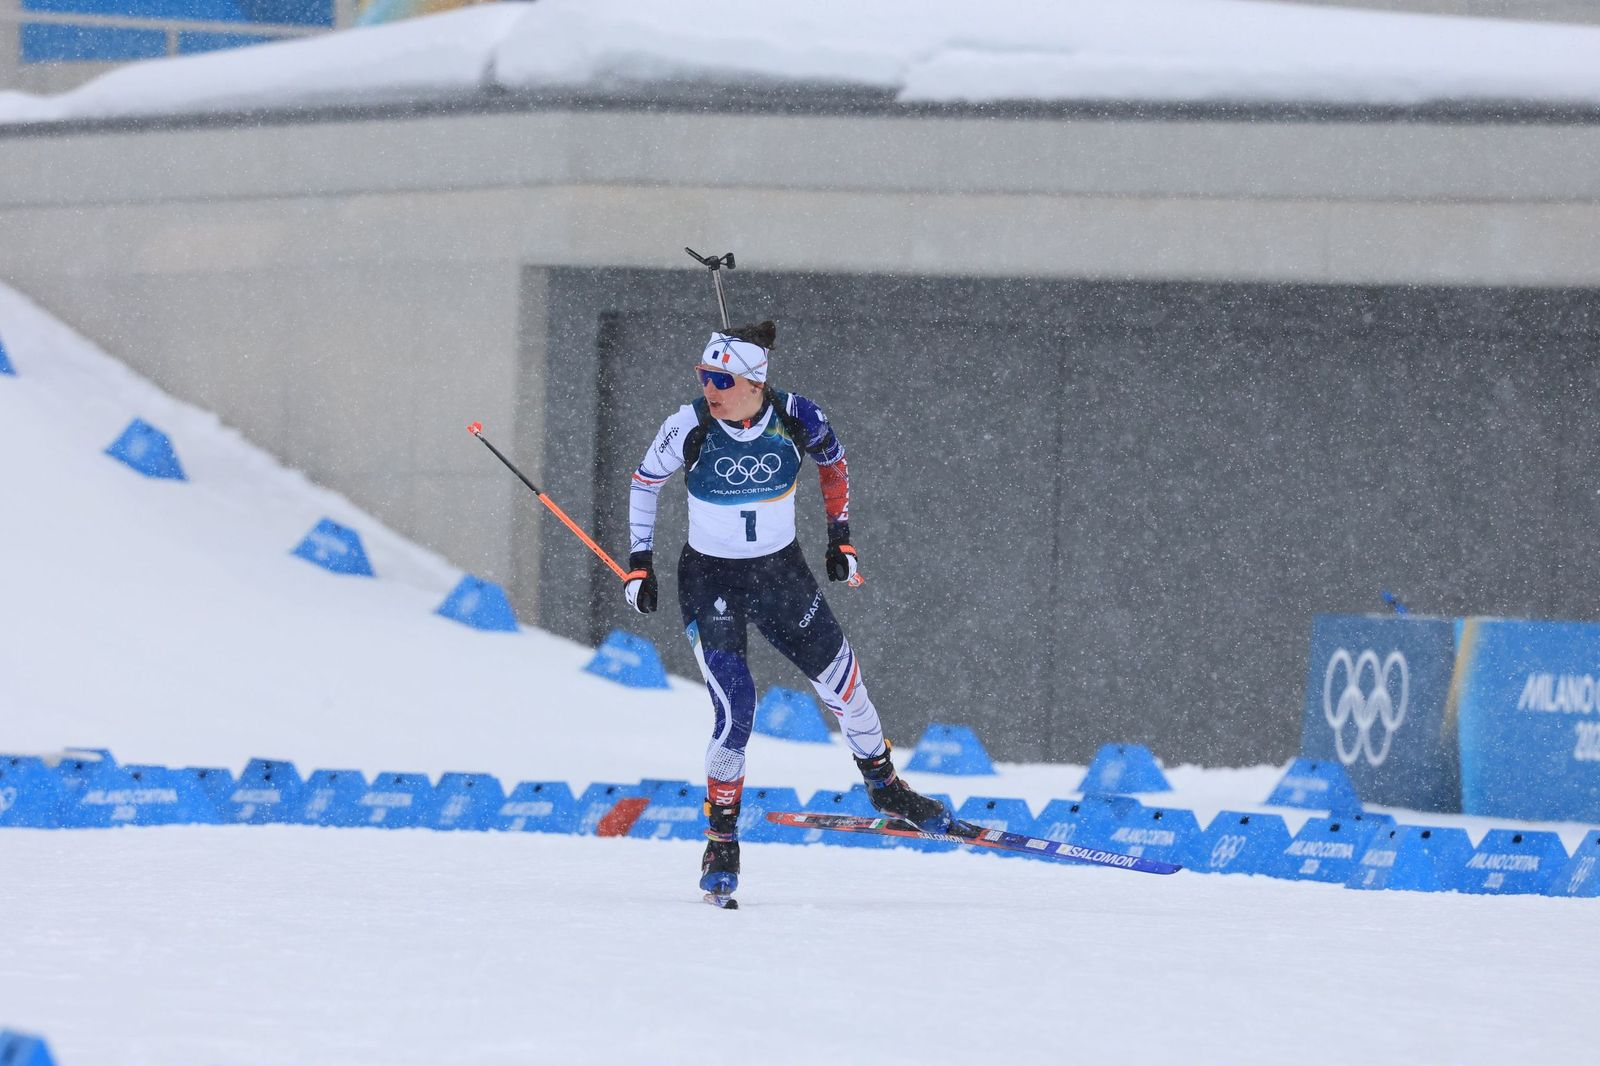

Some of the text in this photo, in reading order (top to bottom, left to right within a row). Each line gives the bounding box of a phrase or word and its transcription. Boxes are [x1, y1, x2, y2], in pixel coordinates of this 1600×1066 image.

[659, 431, 673, 453] CRAFT
[740, 510, 757, 541] 1
[798, 594, 821, 628] CRAFT
[1516, 672, 1595, 715] MILANO
[716, 788, 737, 806] FR
[917, 832, 965, 844] SALOMON
[1069, 846, 1139, 868] SALOMON
